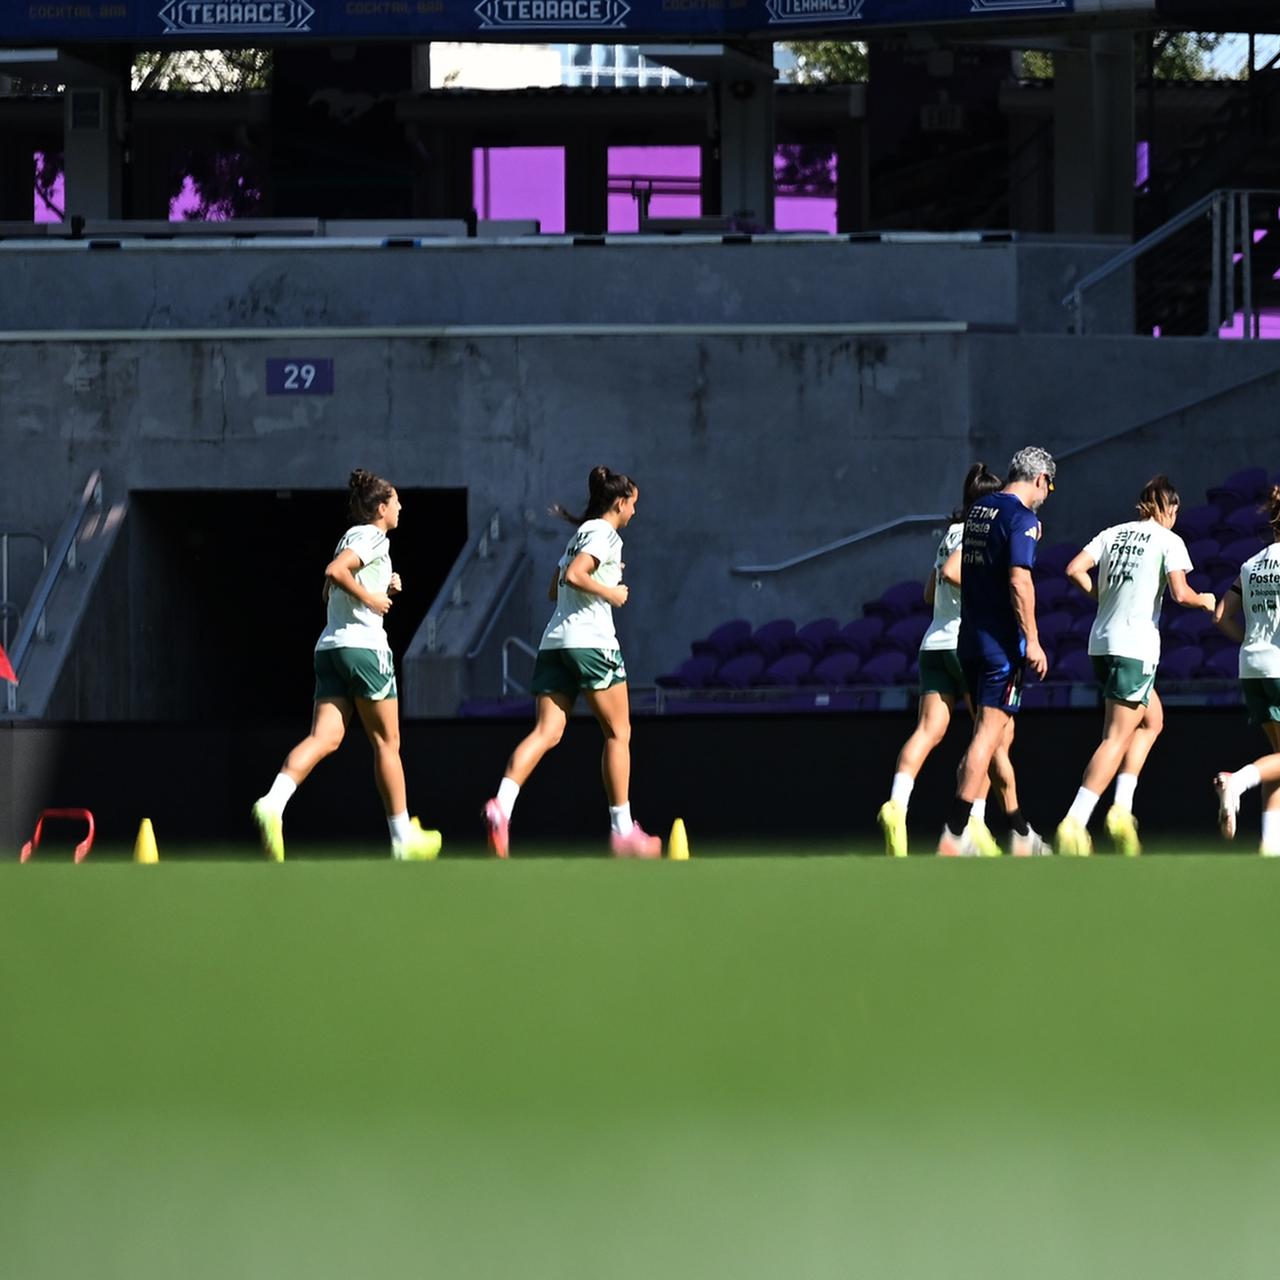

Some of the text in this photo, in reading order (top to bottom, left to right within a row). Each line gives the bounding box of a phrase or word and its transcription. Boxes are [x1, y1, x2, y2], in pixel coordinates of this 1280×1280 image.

[186, 2, 286, 24] TERRACE
[501, 0, 601, 20] TERRACE
[284, 363, 316, 390] 29
[980, 507, 999, 520] TIM
[966, 520, 990, 533] Poste
[1127, 531, 1151, 543] TIM
[1110, 543, 1144, 556] Poste
[1249, 573, 1280, 584] Poste
